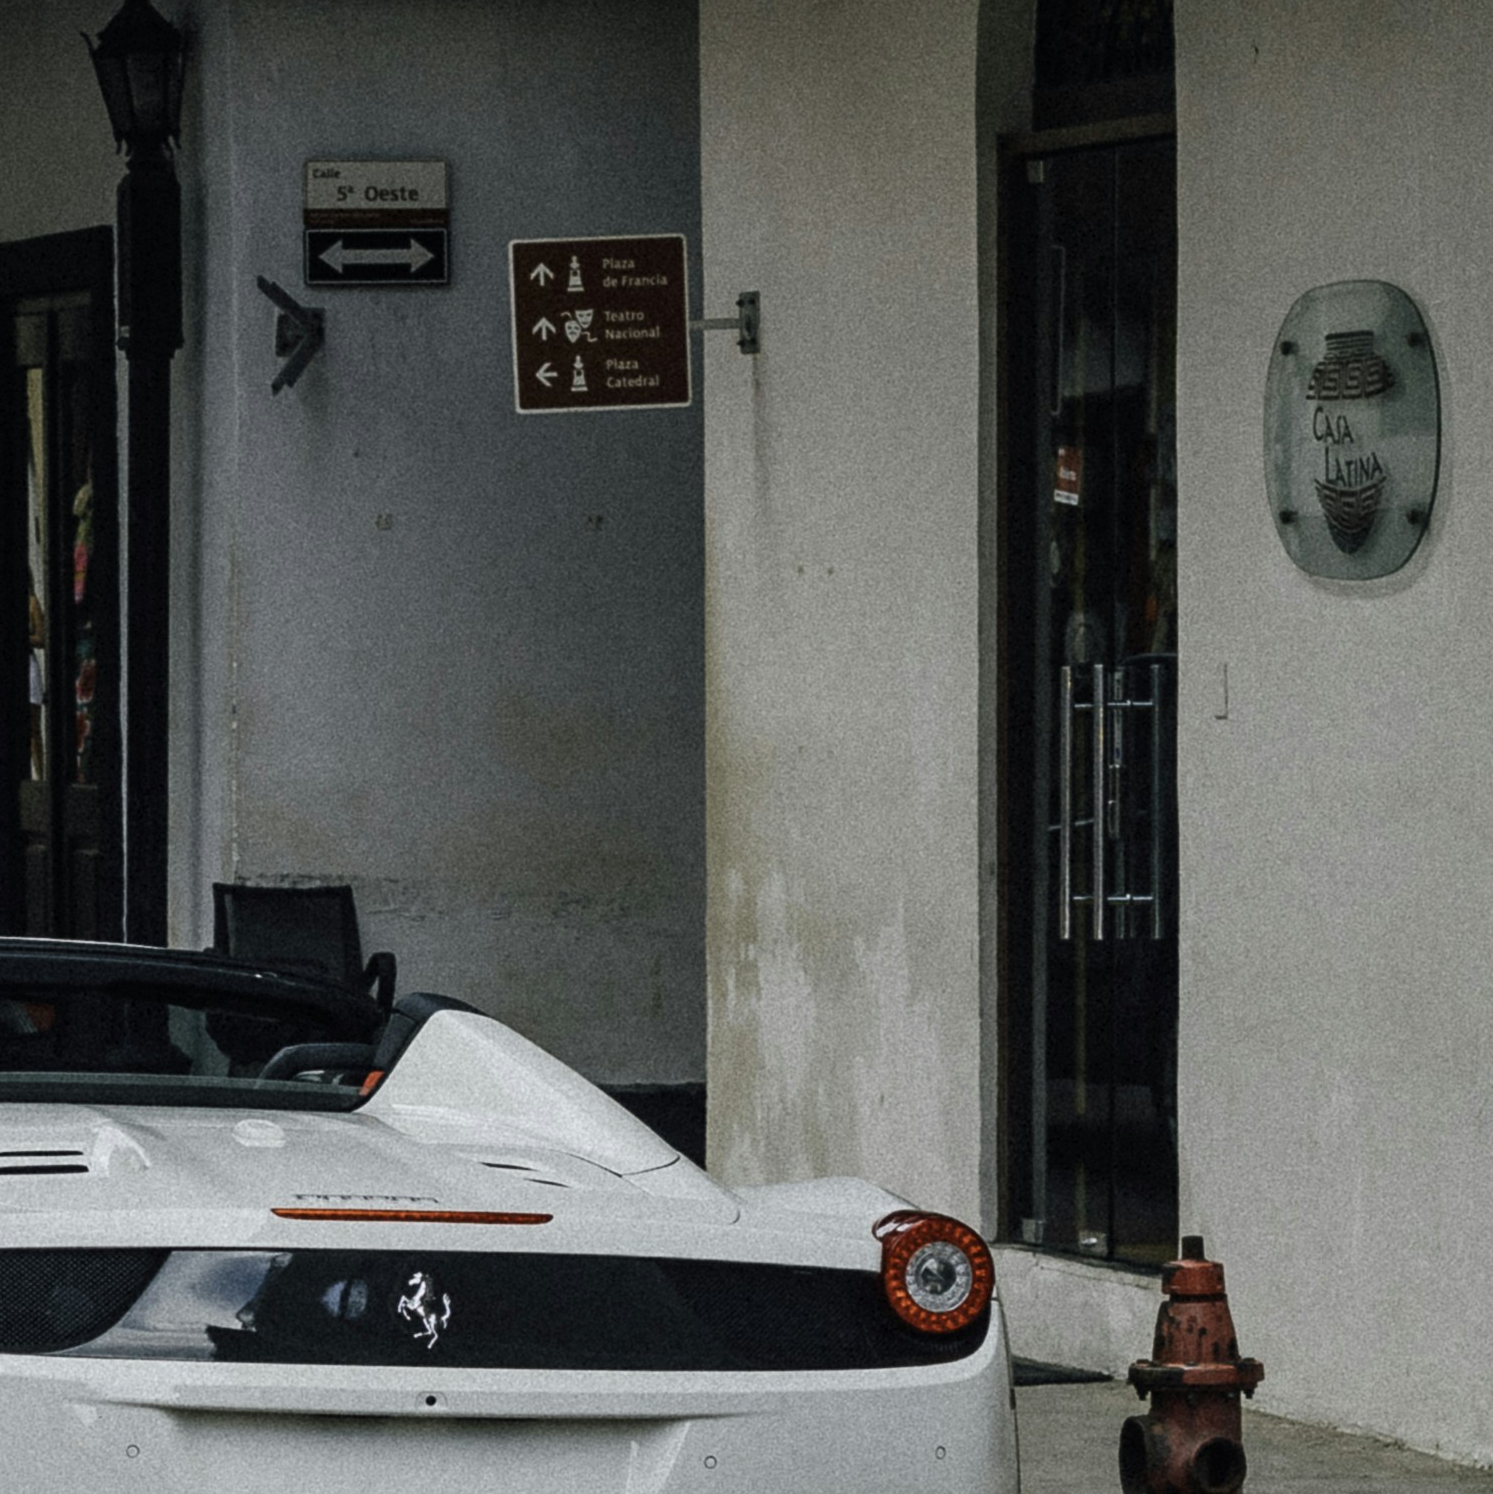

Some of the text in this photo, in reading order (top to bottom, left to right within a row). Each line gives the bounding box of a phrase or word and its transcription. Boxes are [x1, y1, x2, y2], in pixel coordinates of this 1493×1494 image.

[311, 168, 341, 179] Calle
[363, 185, 419, 202] Oeste
[602, 258, 636, 270] Plaza
[602, 273, 668, 288] de Francia
[604, 310, 645, 323] Teatro
[605, 326, 661, 340] Nacional
[606, 358, 640, 370] Plaza
[606, 374, 660, 389] Catedral
[1312, 405, 1355, 445] CASA
[1324, 446, 1384, 488] LATINA
